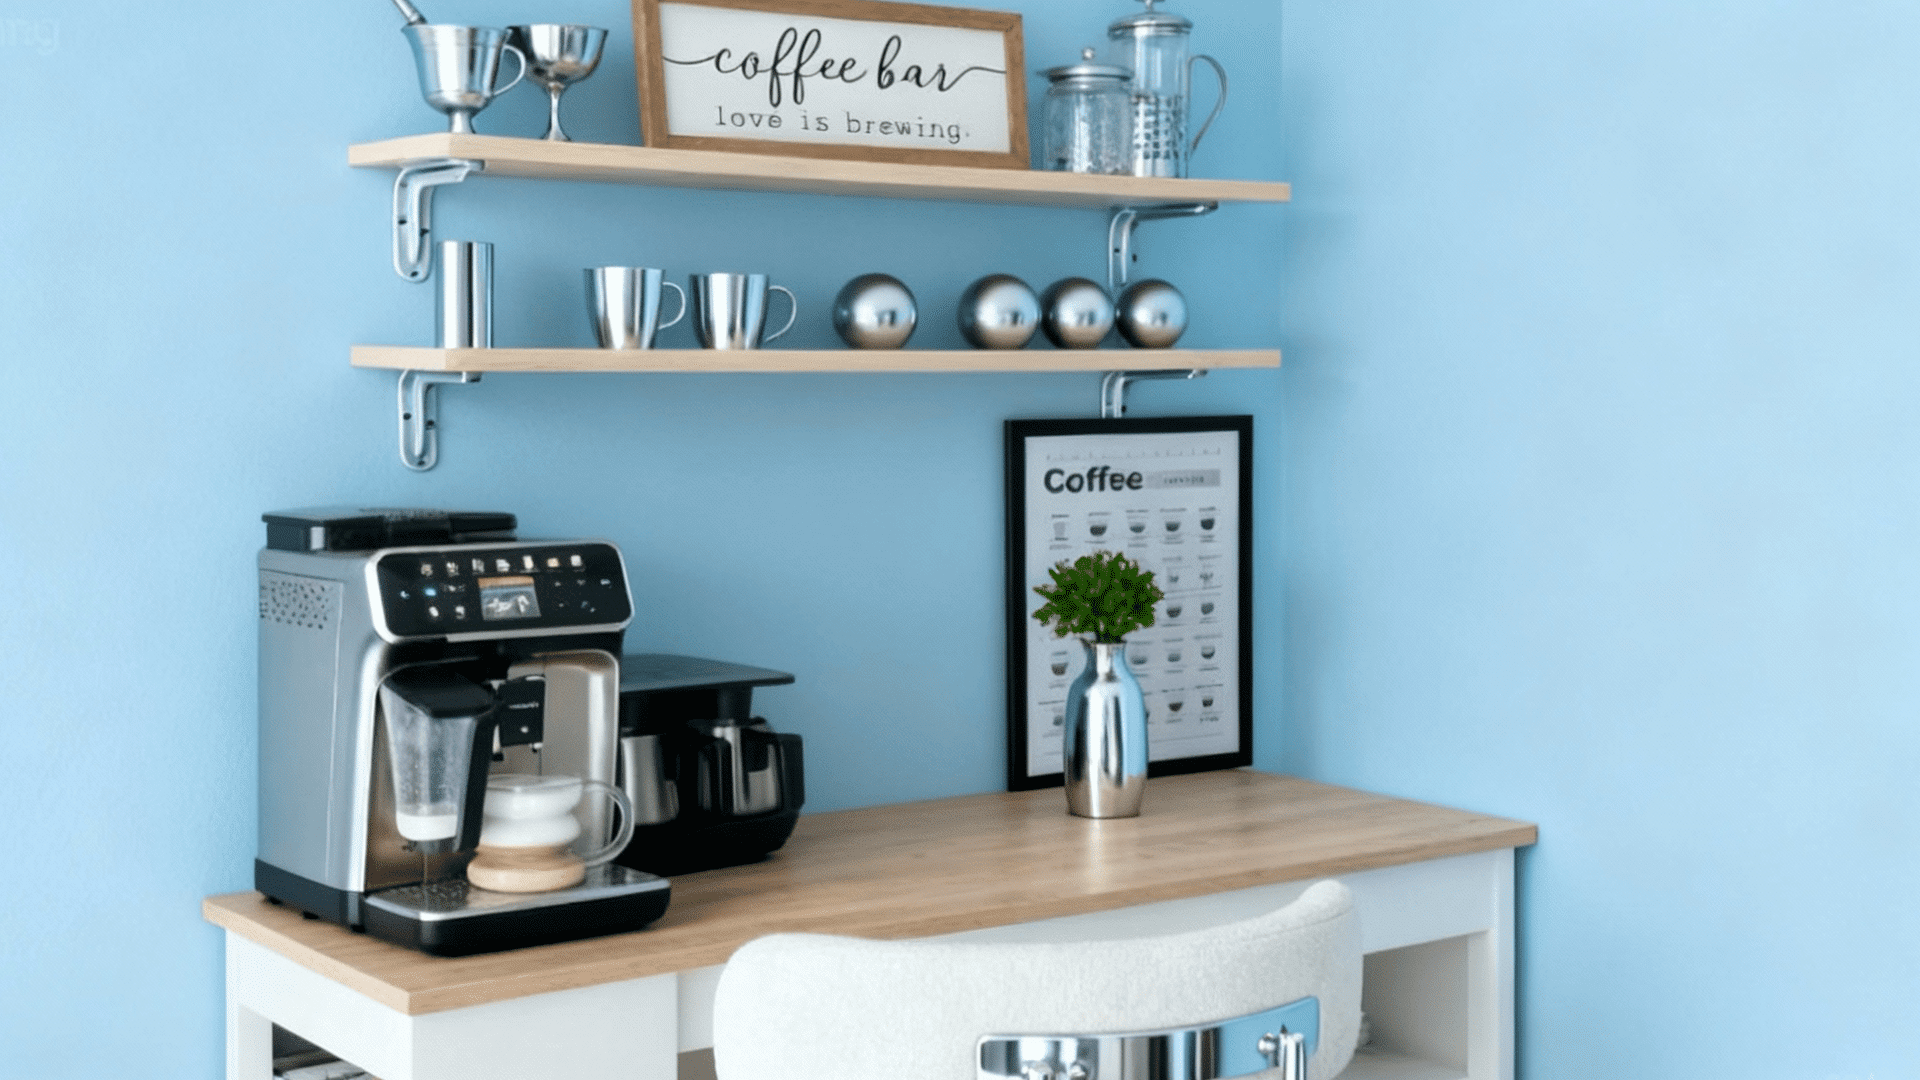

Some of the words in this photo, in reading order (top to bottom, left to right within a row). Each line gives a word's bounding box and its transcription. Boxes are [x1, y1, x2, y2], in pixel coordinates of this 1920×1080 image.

[663, 27, 867, 108] coffee
[877, 35, 1006, 92] bar
[714, 105, 782, 129] love
[800, 109, 829, 132] is
[1044, 465, 1144, 494] Coffee
